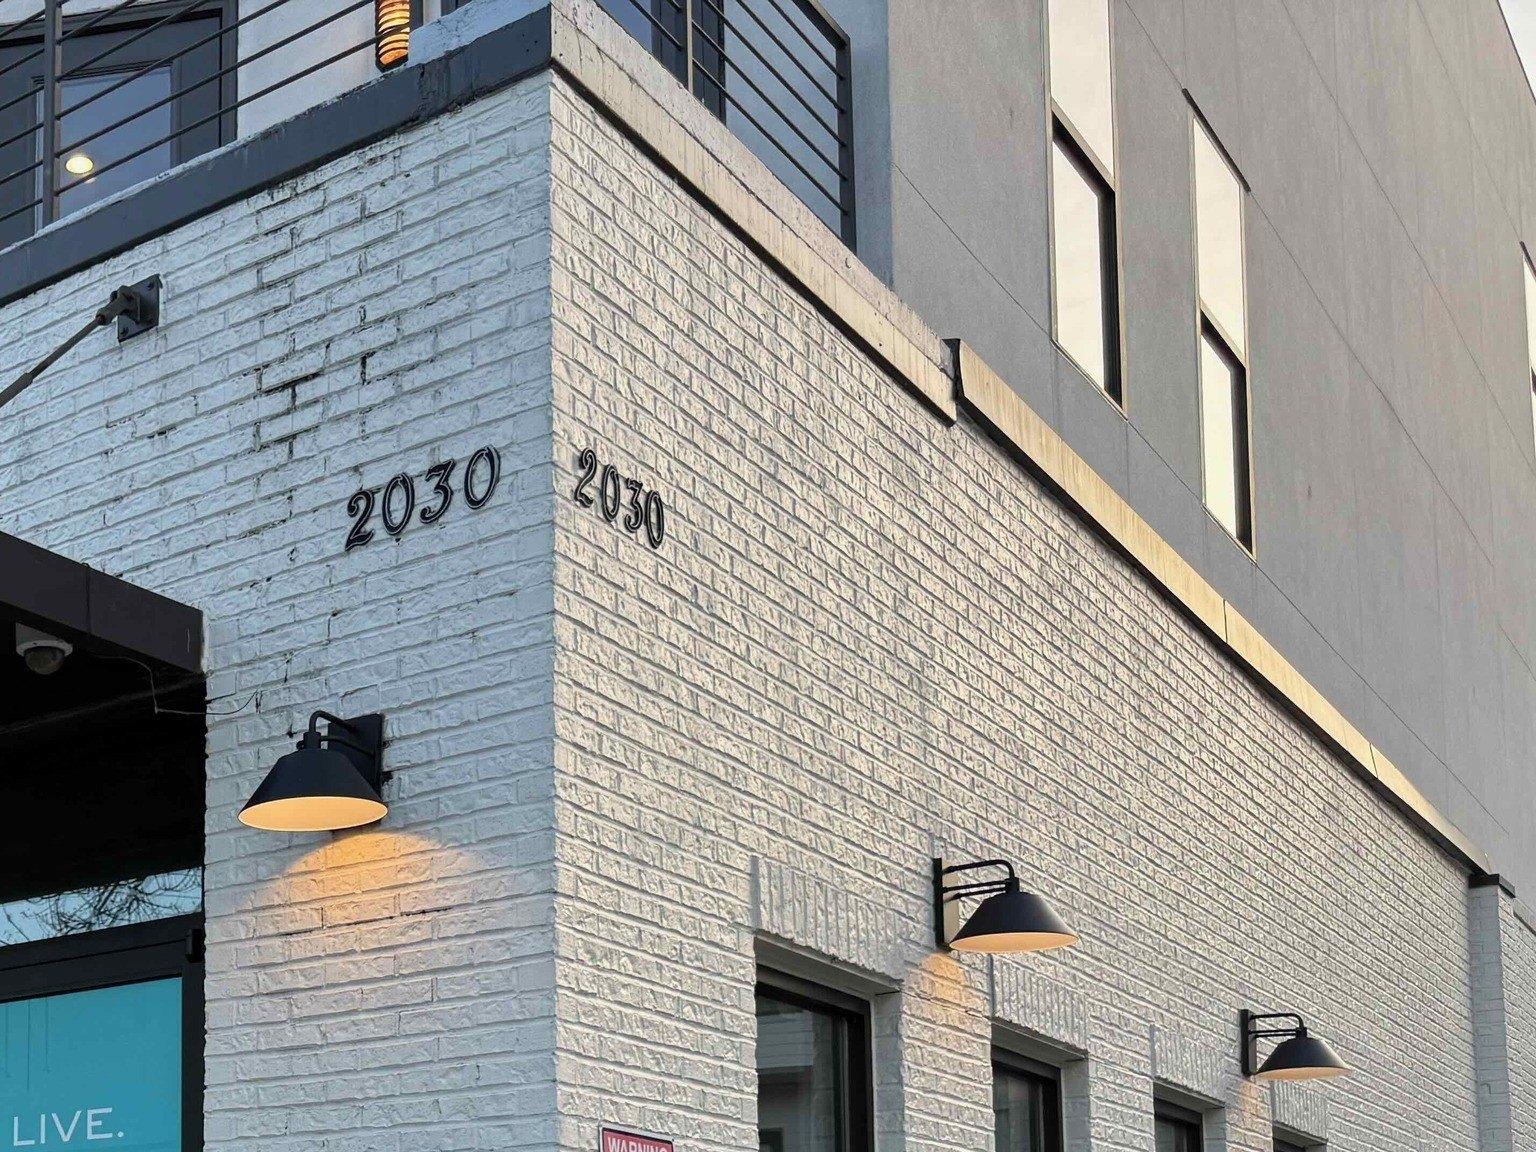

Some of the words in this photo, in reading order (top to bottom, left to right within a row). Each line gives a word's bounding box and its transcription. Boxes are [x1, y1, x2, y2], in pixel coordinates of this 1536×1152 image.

[345, 446, 501, 551] 2030
[573, 447, 665, 549] 2030
[13, 1106, 125, 1147] LIVE.
